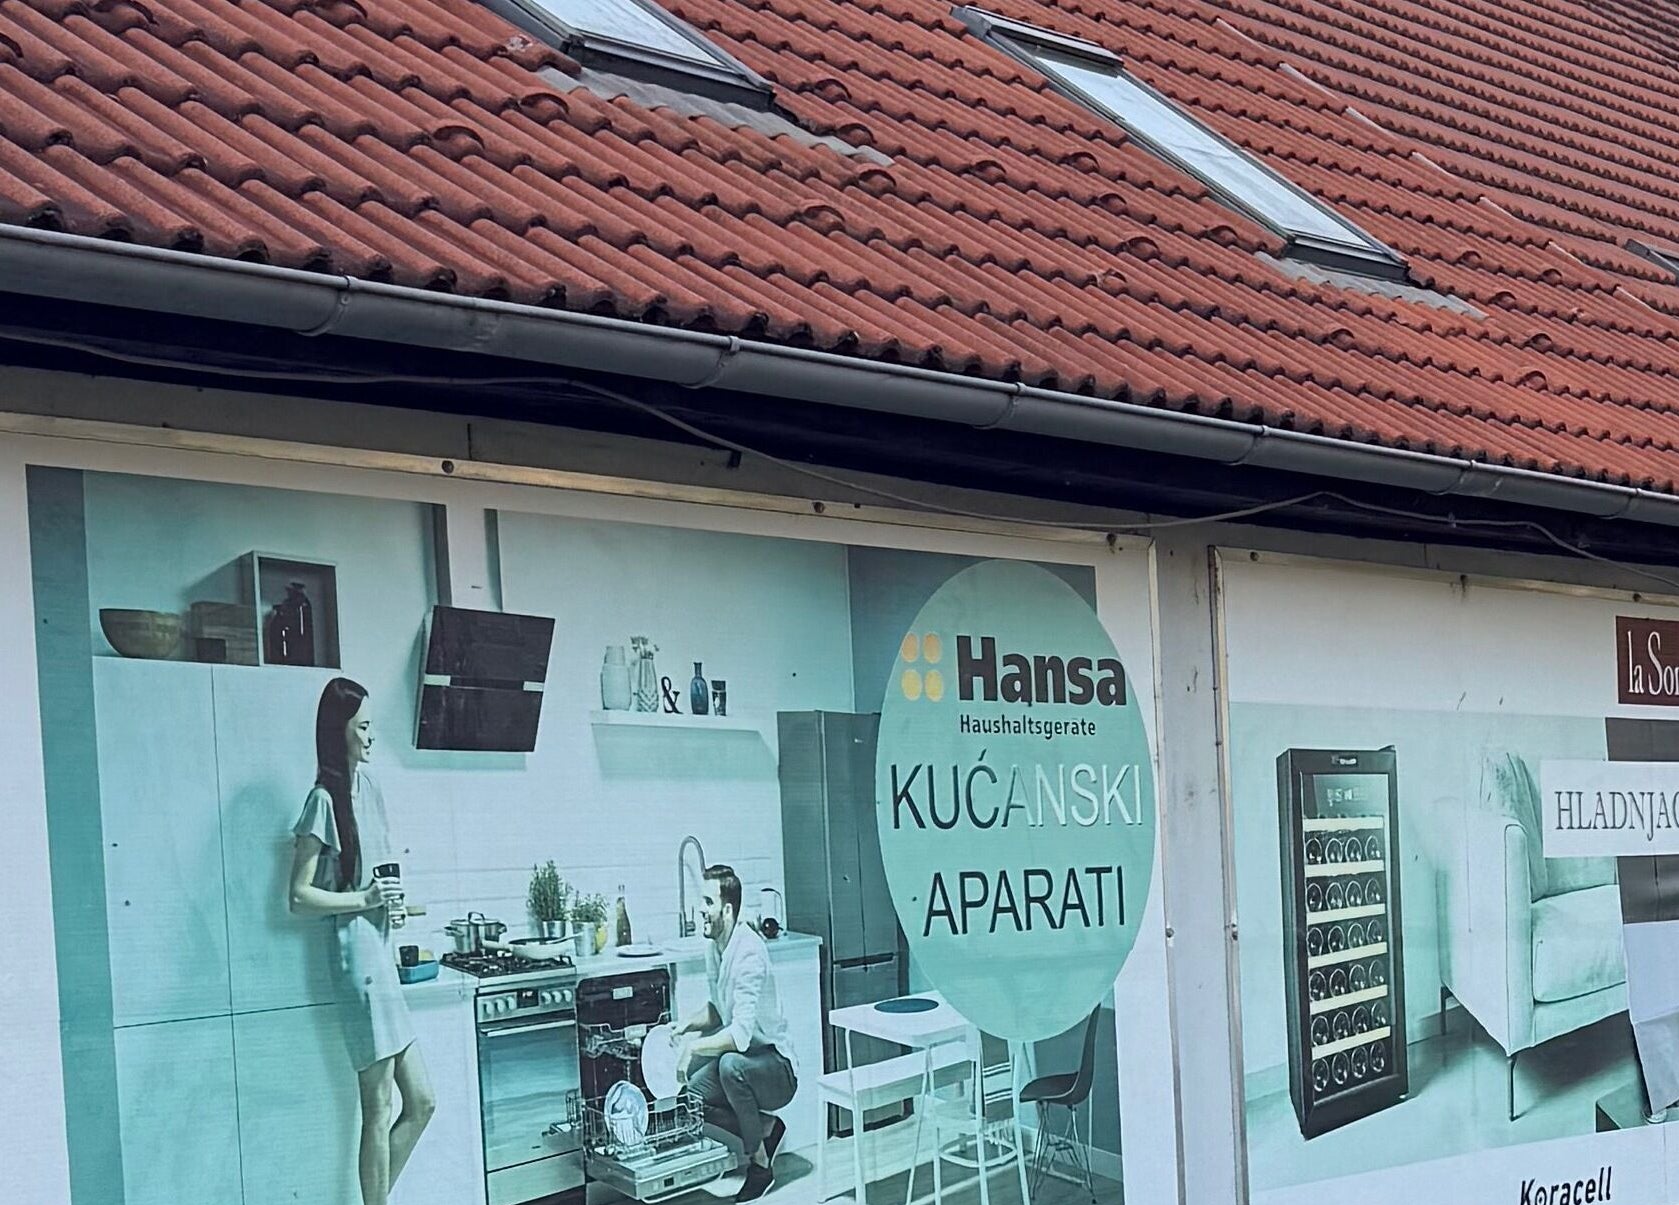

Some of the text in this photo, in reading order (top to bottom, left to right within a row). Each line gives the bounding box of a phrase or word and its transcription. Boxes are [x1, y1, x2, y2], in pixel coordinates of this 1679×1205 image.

[956, 635, 1127, 707] Hansa
[1627, 630, 1644, 694] la
[890, 748, 1144, 830] KUĆANSKI
[923, 865, 1126, 937] APARATI
